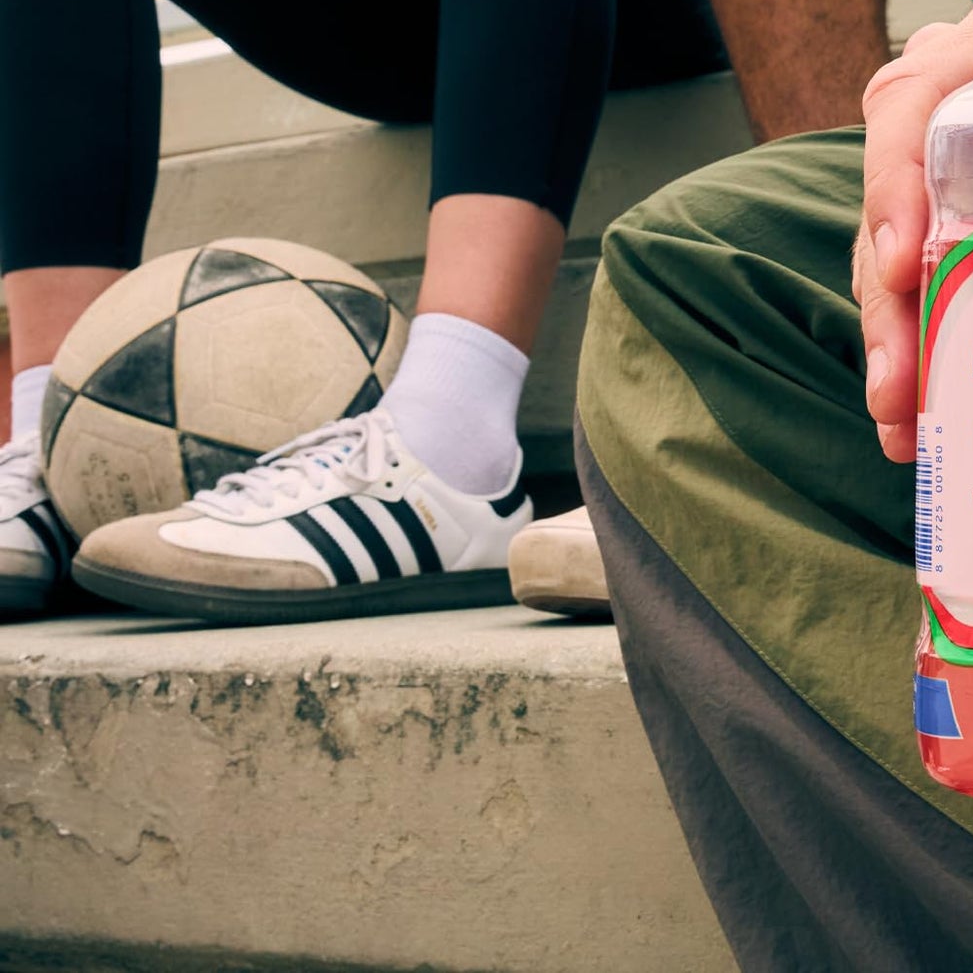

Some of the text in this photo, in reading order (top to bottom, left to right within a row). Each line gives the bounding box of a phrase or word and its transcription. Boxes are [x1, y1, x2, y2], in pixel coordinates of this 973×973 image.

[935, 426, 943, 572] 8 87725 00180 8
